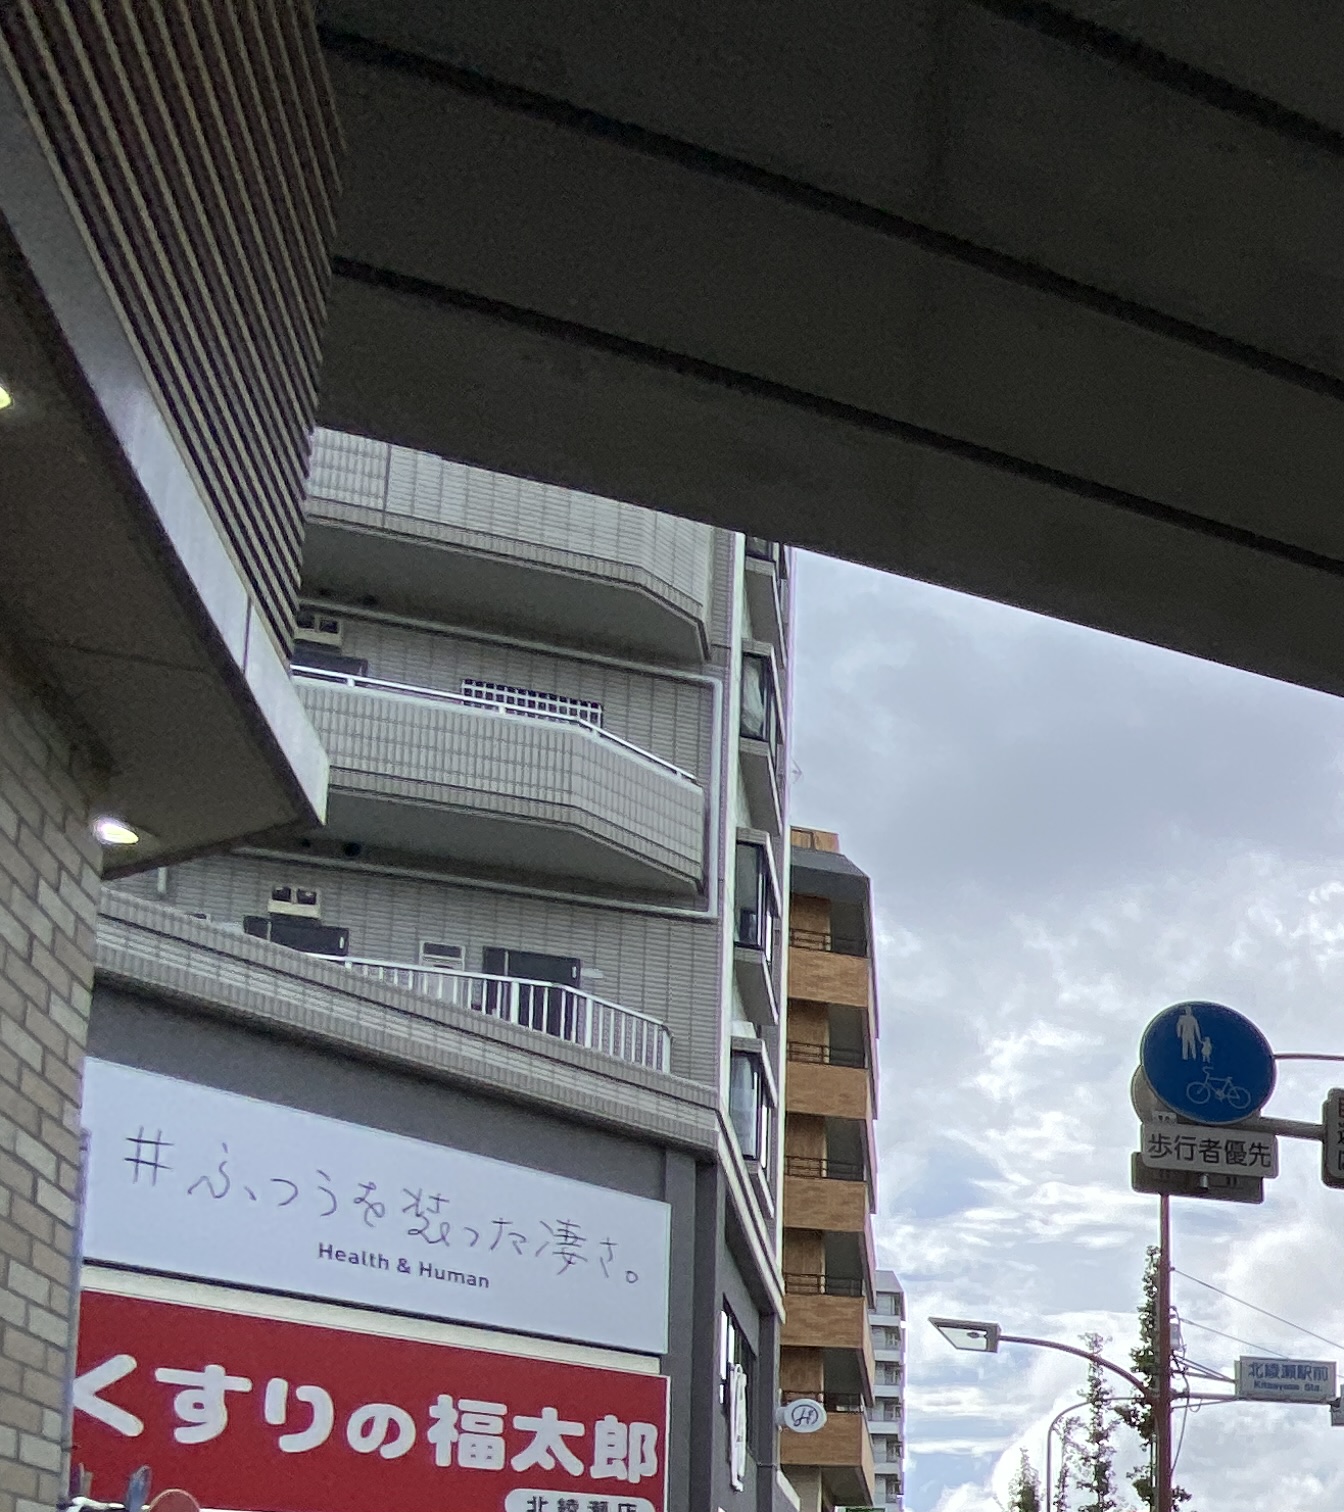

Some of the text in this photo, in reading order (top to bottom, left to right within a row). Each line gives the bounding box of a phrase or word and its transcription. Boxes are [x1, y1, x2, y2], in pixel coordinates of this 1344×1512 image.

[1148, 1133, 1271, 1167] 歩行者優先
[318, 1242, 491, 1289] Health & Human
[73, 1353, 659, 1485] くすりの福太郎
